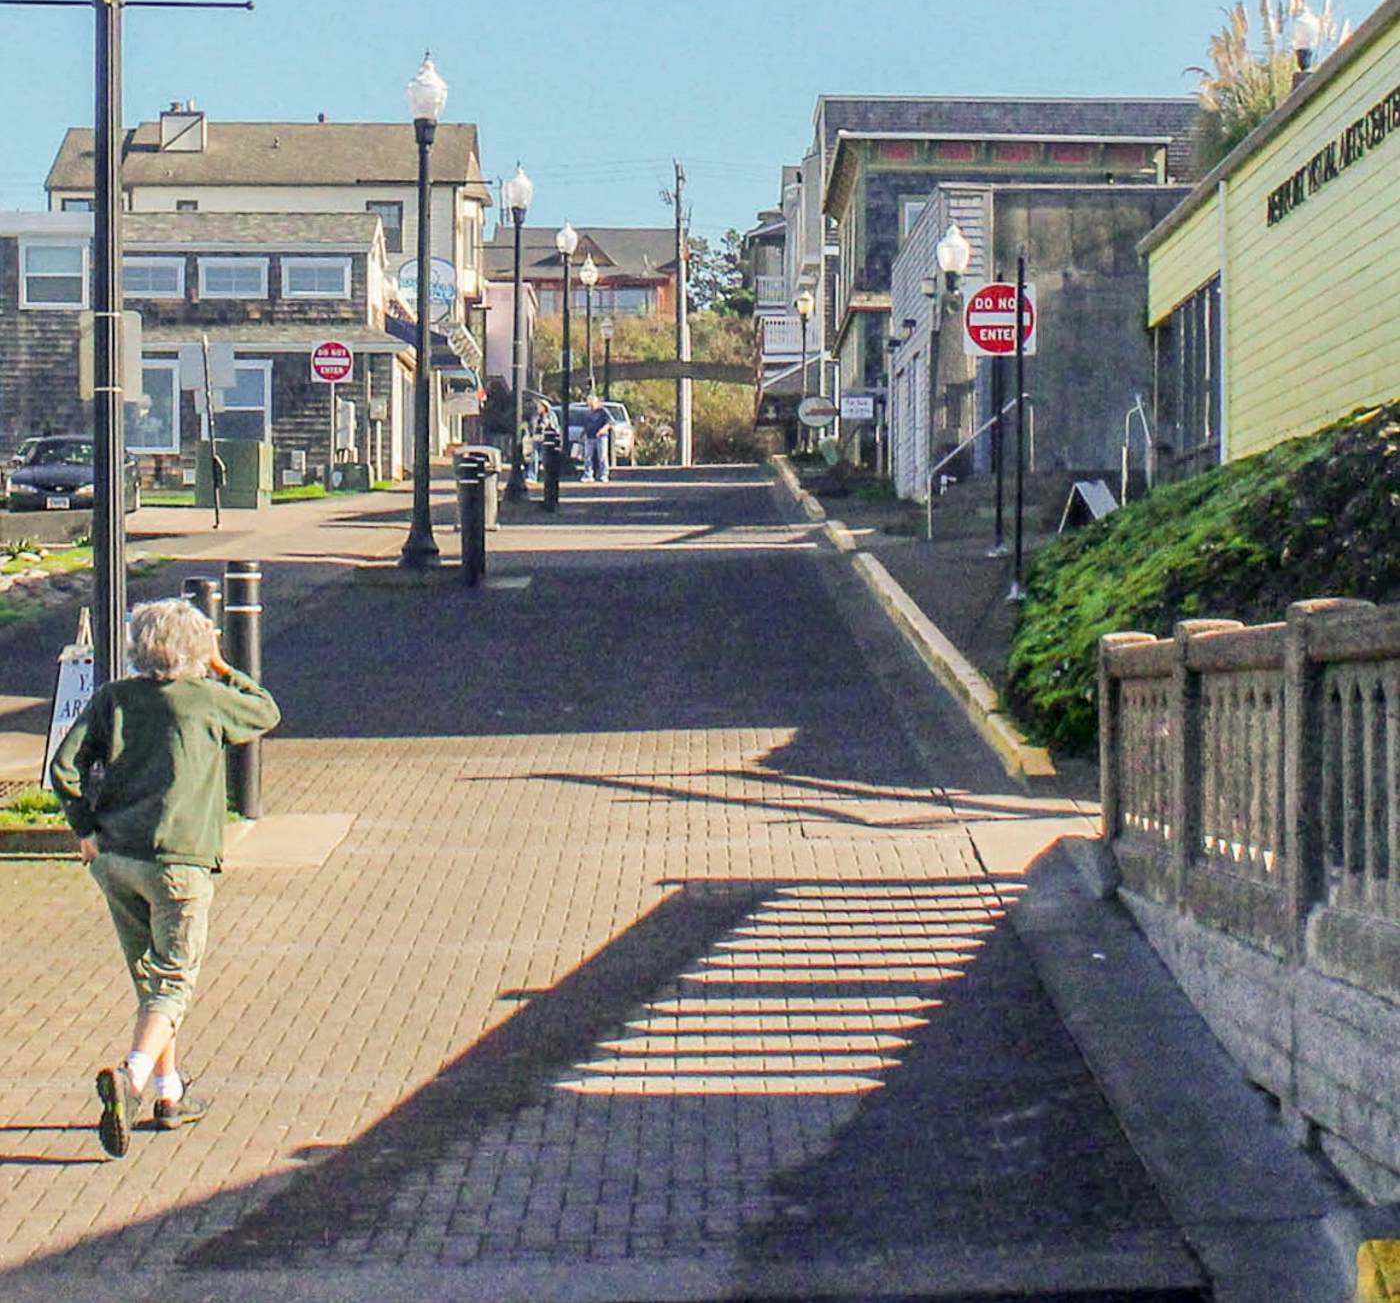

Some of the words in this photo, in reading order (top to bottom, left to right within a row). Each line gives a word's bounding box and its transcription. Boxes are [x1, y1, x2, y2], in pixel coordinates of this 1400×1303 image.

[1339, 116, 1364, 171] ARTS
[975, 297, 993, 310] DO
[998, 297, 1017, 310] NO
[979, 328, 1017, 341] ENTE
